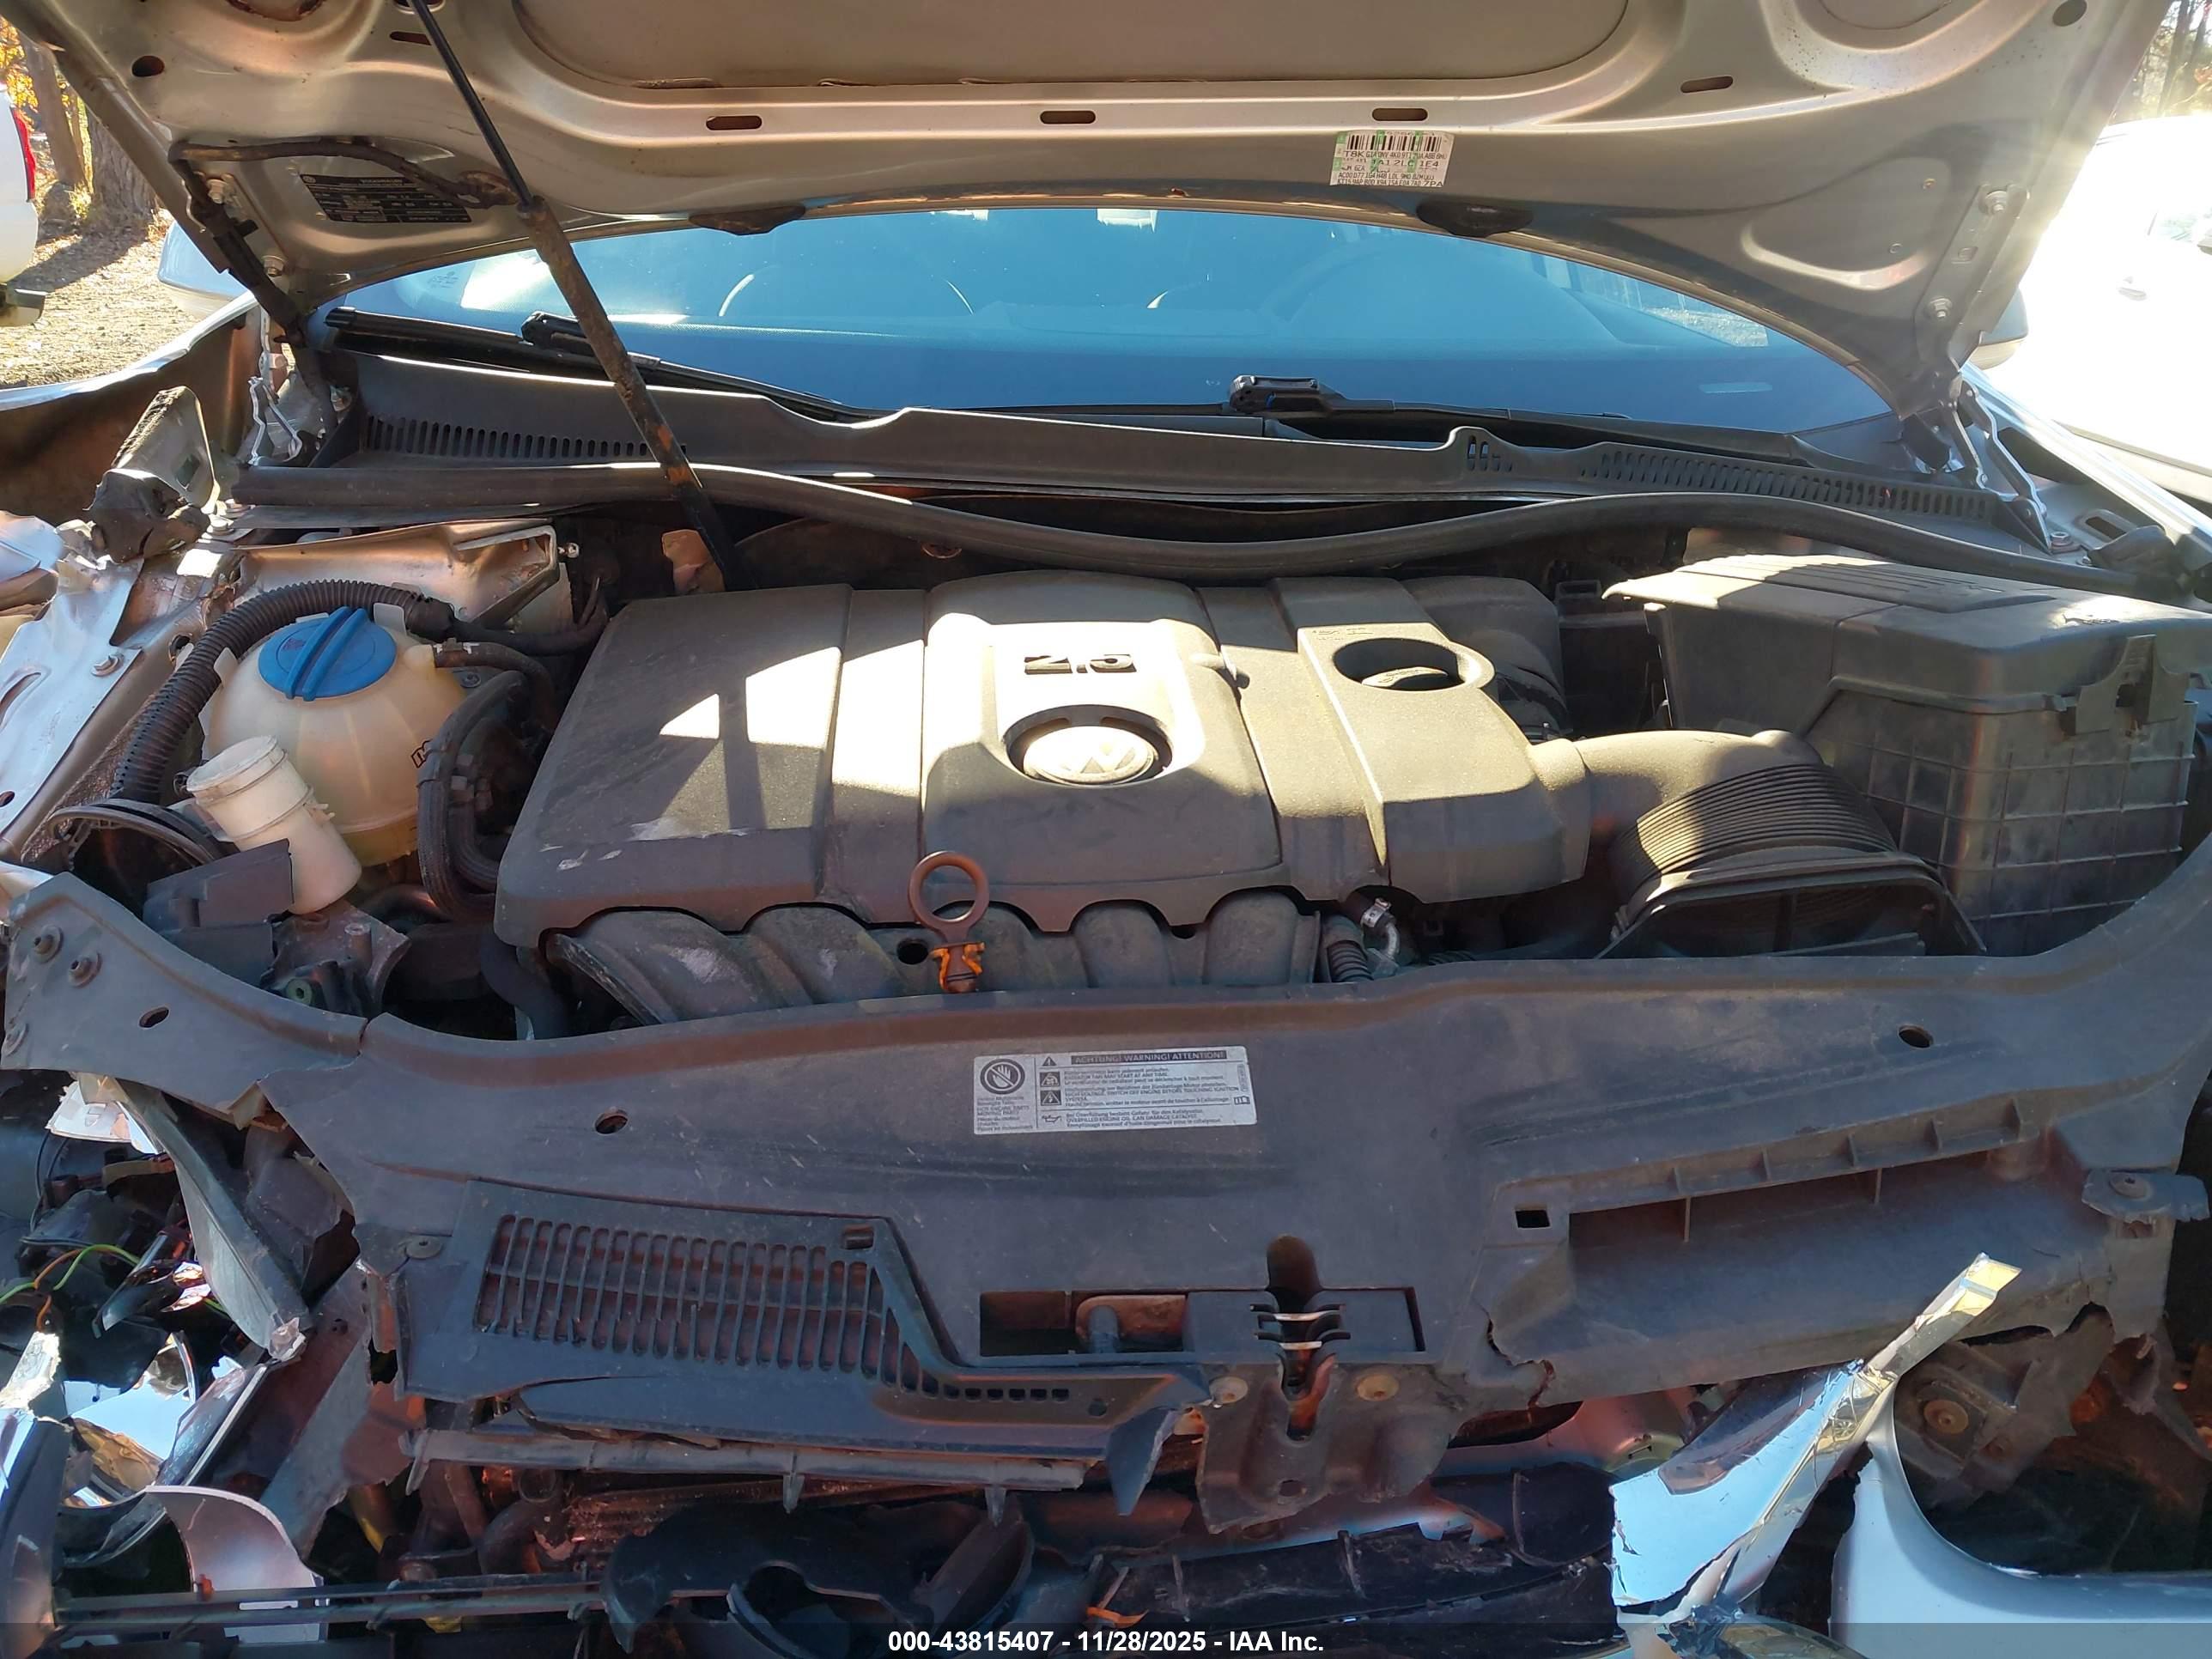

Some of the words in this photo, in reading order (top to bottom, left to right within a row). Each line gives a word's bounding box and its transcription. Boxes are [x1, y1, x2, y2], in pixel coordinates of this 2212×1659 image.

[1024, 653, 1136, 675] 2.5
[1075, 1055, 1122, 1063] ACHTUNG!
[1124, 1053, 1170, 1061] WARNING!
[1171, 1051, 1225, 1059] ATTENTION!
